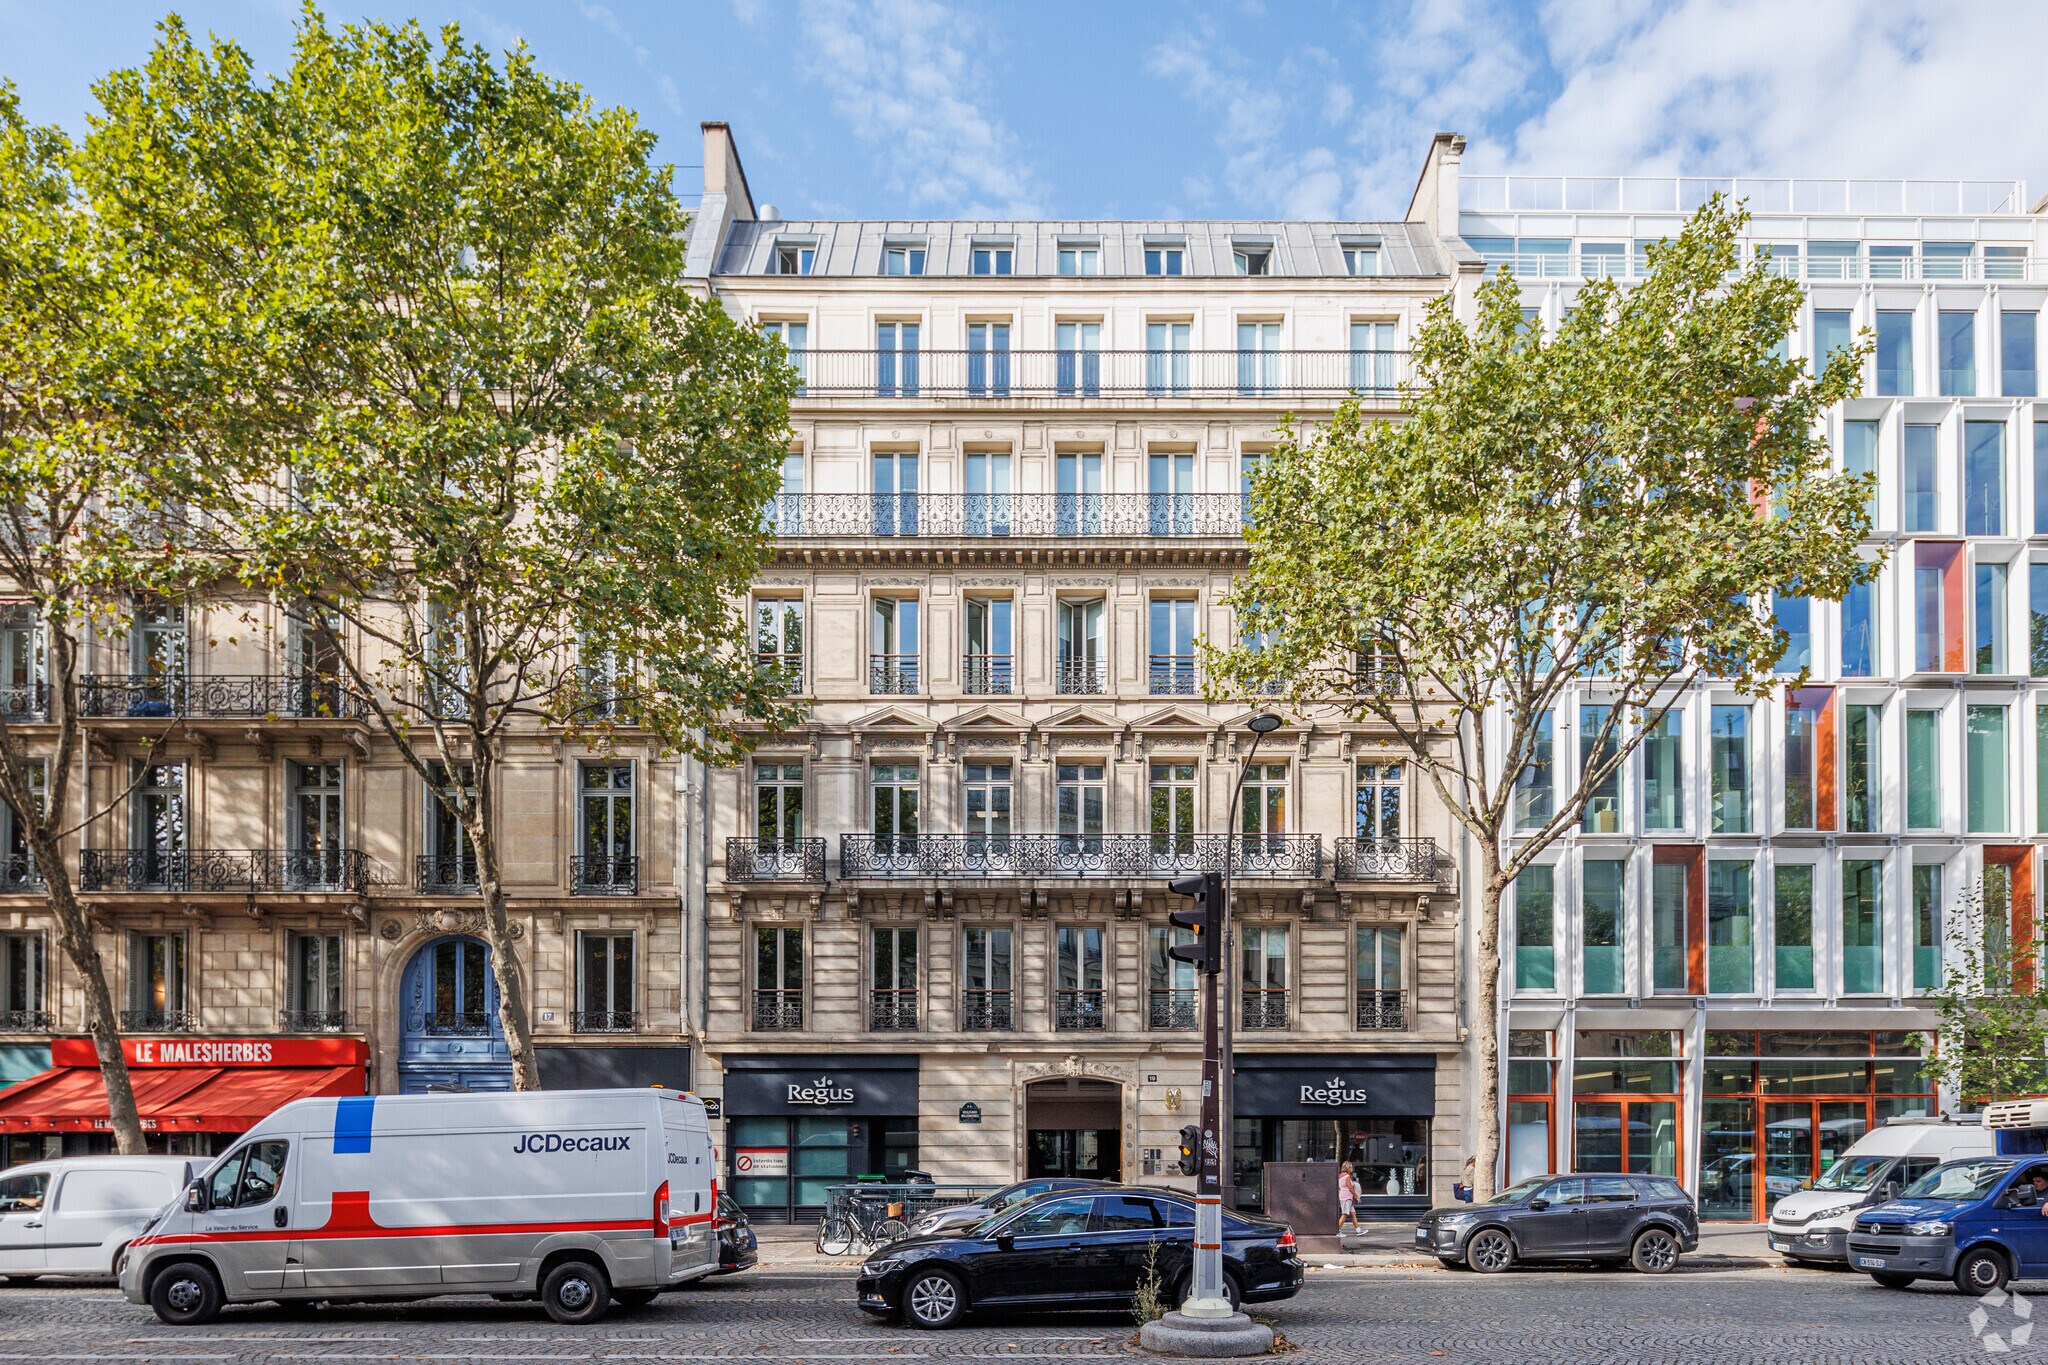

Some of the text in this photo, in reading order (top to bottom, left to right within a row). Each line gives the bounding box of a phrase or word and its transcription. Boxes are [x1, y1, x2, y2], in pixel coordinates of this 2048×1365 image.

[135, 1042, 272, 1063] LE MALESHERBES
[788, 1084, 854, 1105] Regus
[1300, 1085, 1367, 1106] Regus
[95, 1120, 103, 1128] LE
[513, 1134, 631, 1154] JCDecaux
[667, 1152, 688, 1165] JCDecaux
